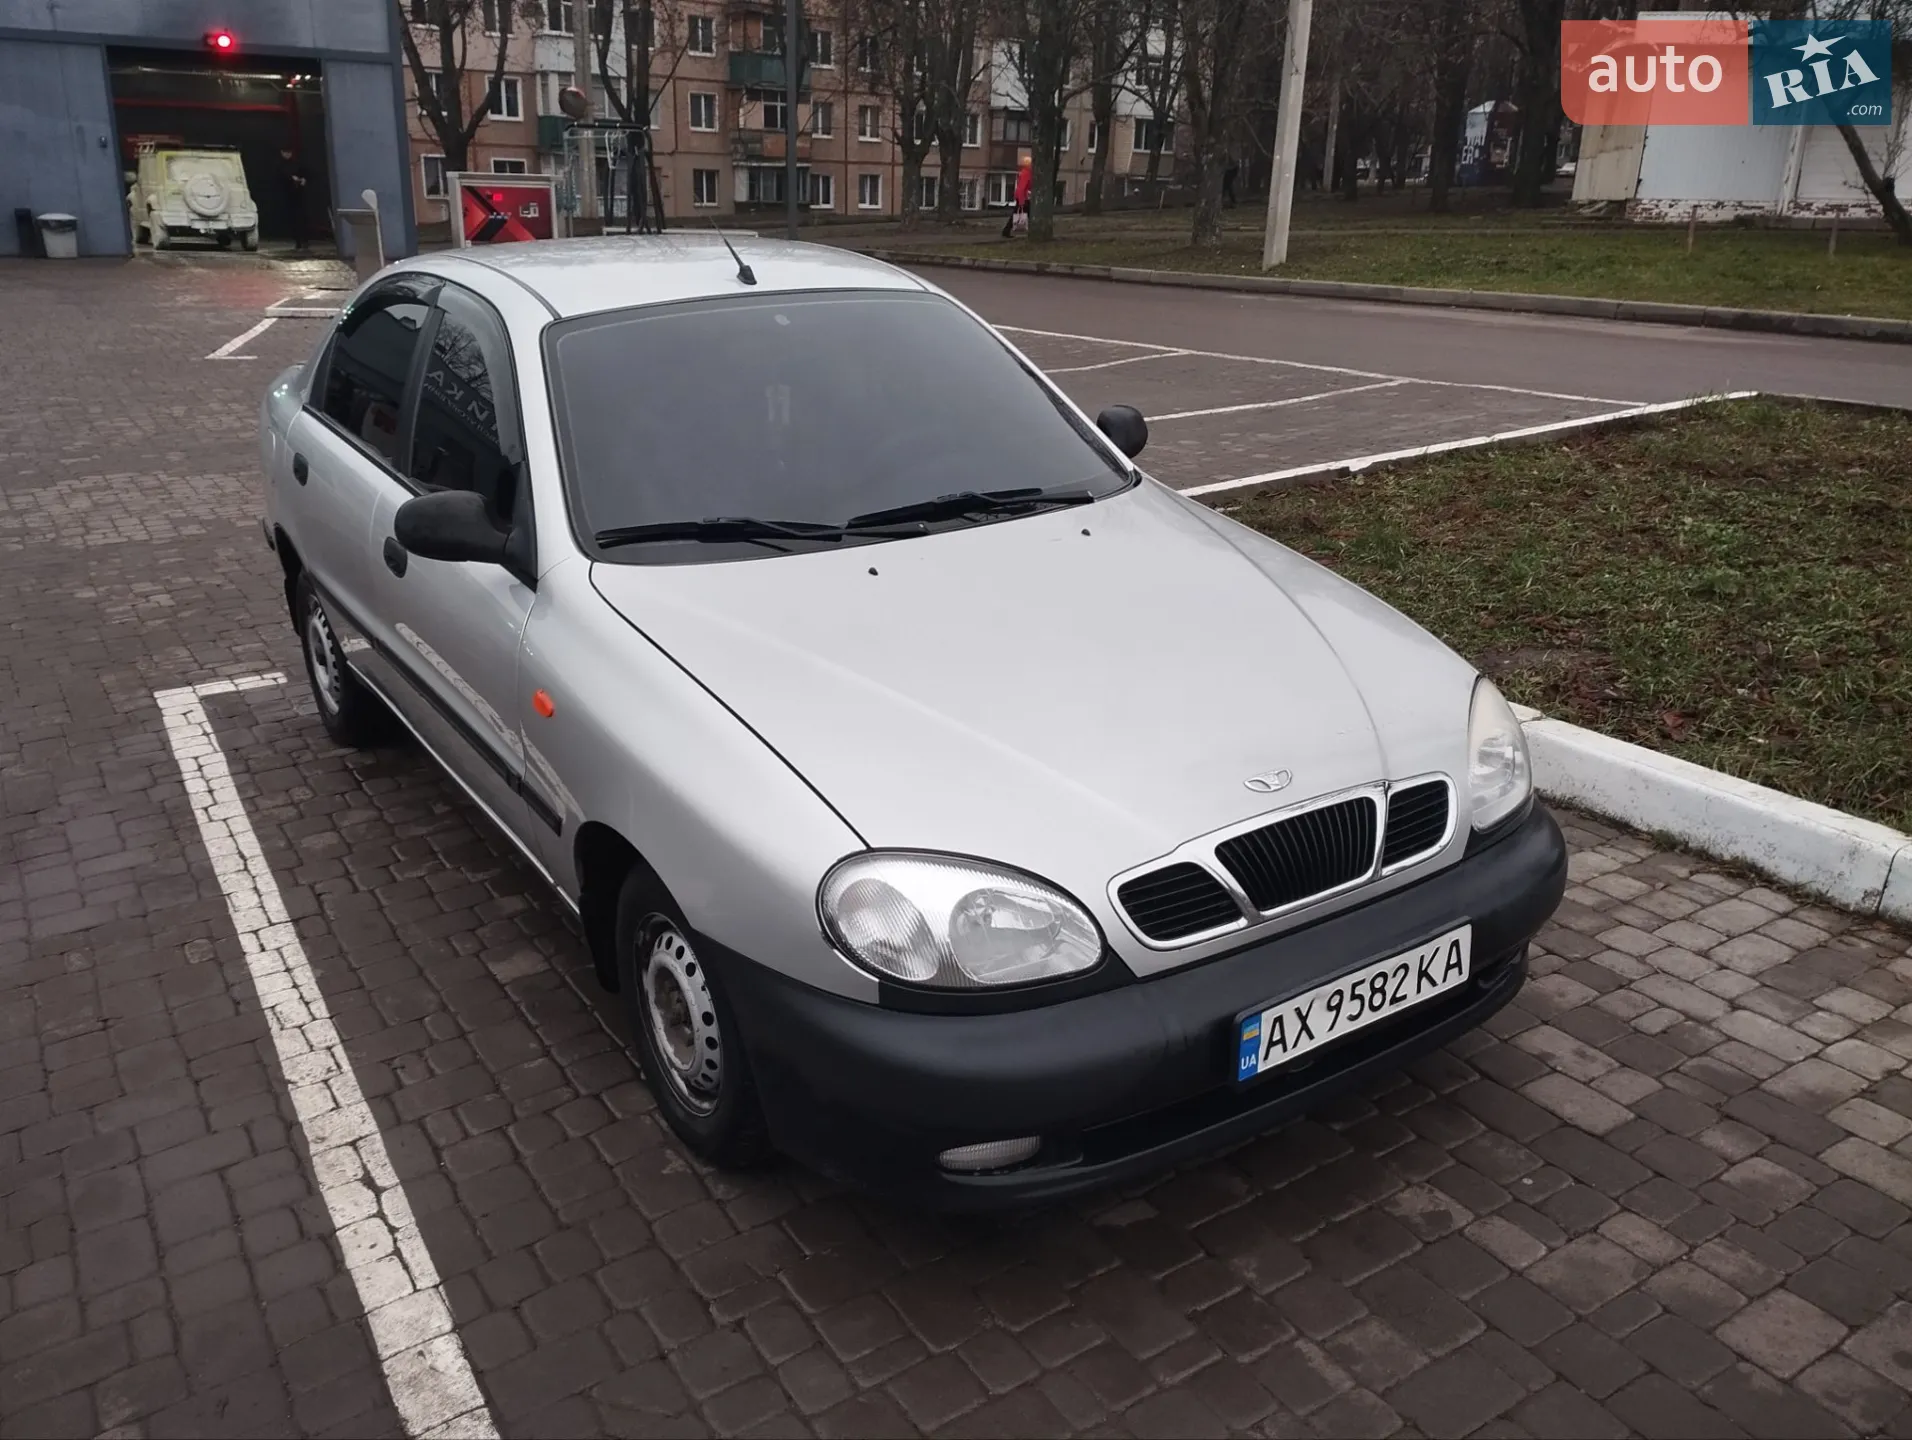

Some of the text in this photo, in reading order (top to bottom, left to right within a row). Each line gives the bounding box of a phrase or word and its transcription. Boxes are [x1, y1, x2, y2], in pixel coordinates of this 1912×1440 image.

[1263, 938, 1464, 1061] AX 9582 KA
[1241, 1056, 1257, 1070] UA
